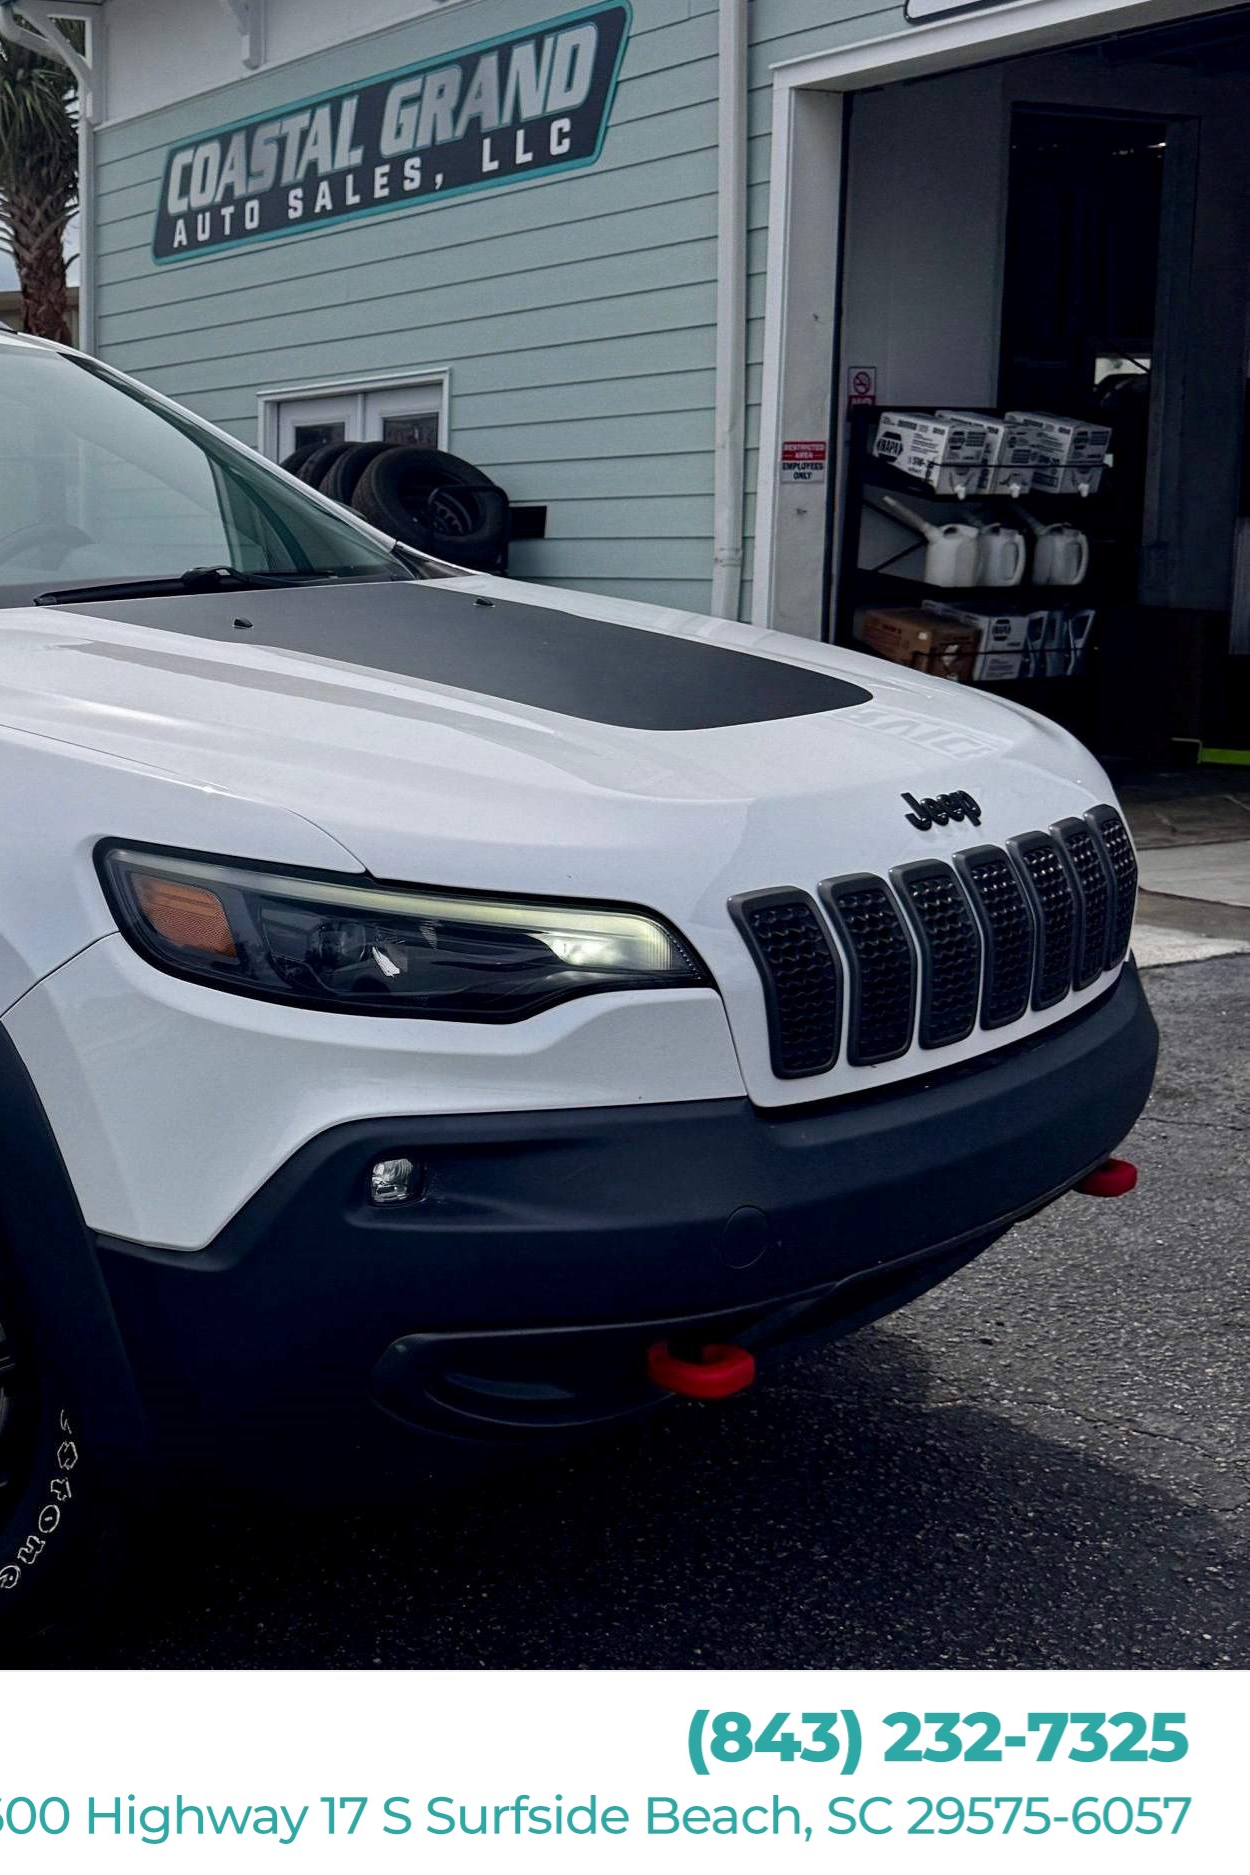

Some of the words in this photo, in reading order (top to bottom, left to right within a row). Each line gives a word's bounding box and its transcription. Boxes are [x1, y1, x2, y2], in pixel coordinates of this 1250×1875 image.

[166, 95, 364, 215] COASTAL
[380, 21, 598, 159] GRAND
[172, 198, 259, 249] AUTO
[287, 157, 445, 219] SALES,
[481, 118, 571, 173] LLC
[782, 462, 824, 470] EMPLOYEES
[793, 471, 812, 480] ONLY
[900, 789, 982, 831] Jeep
